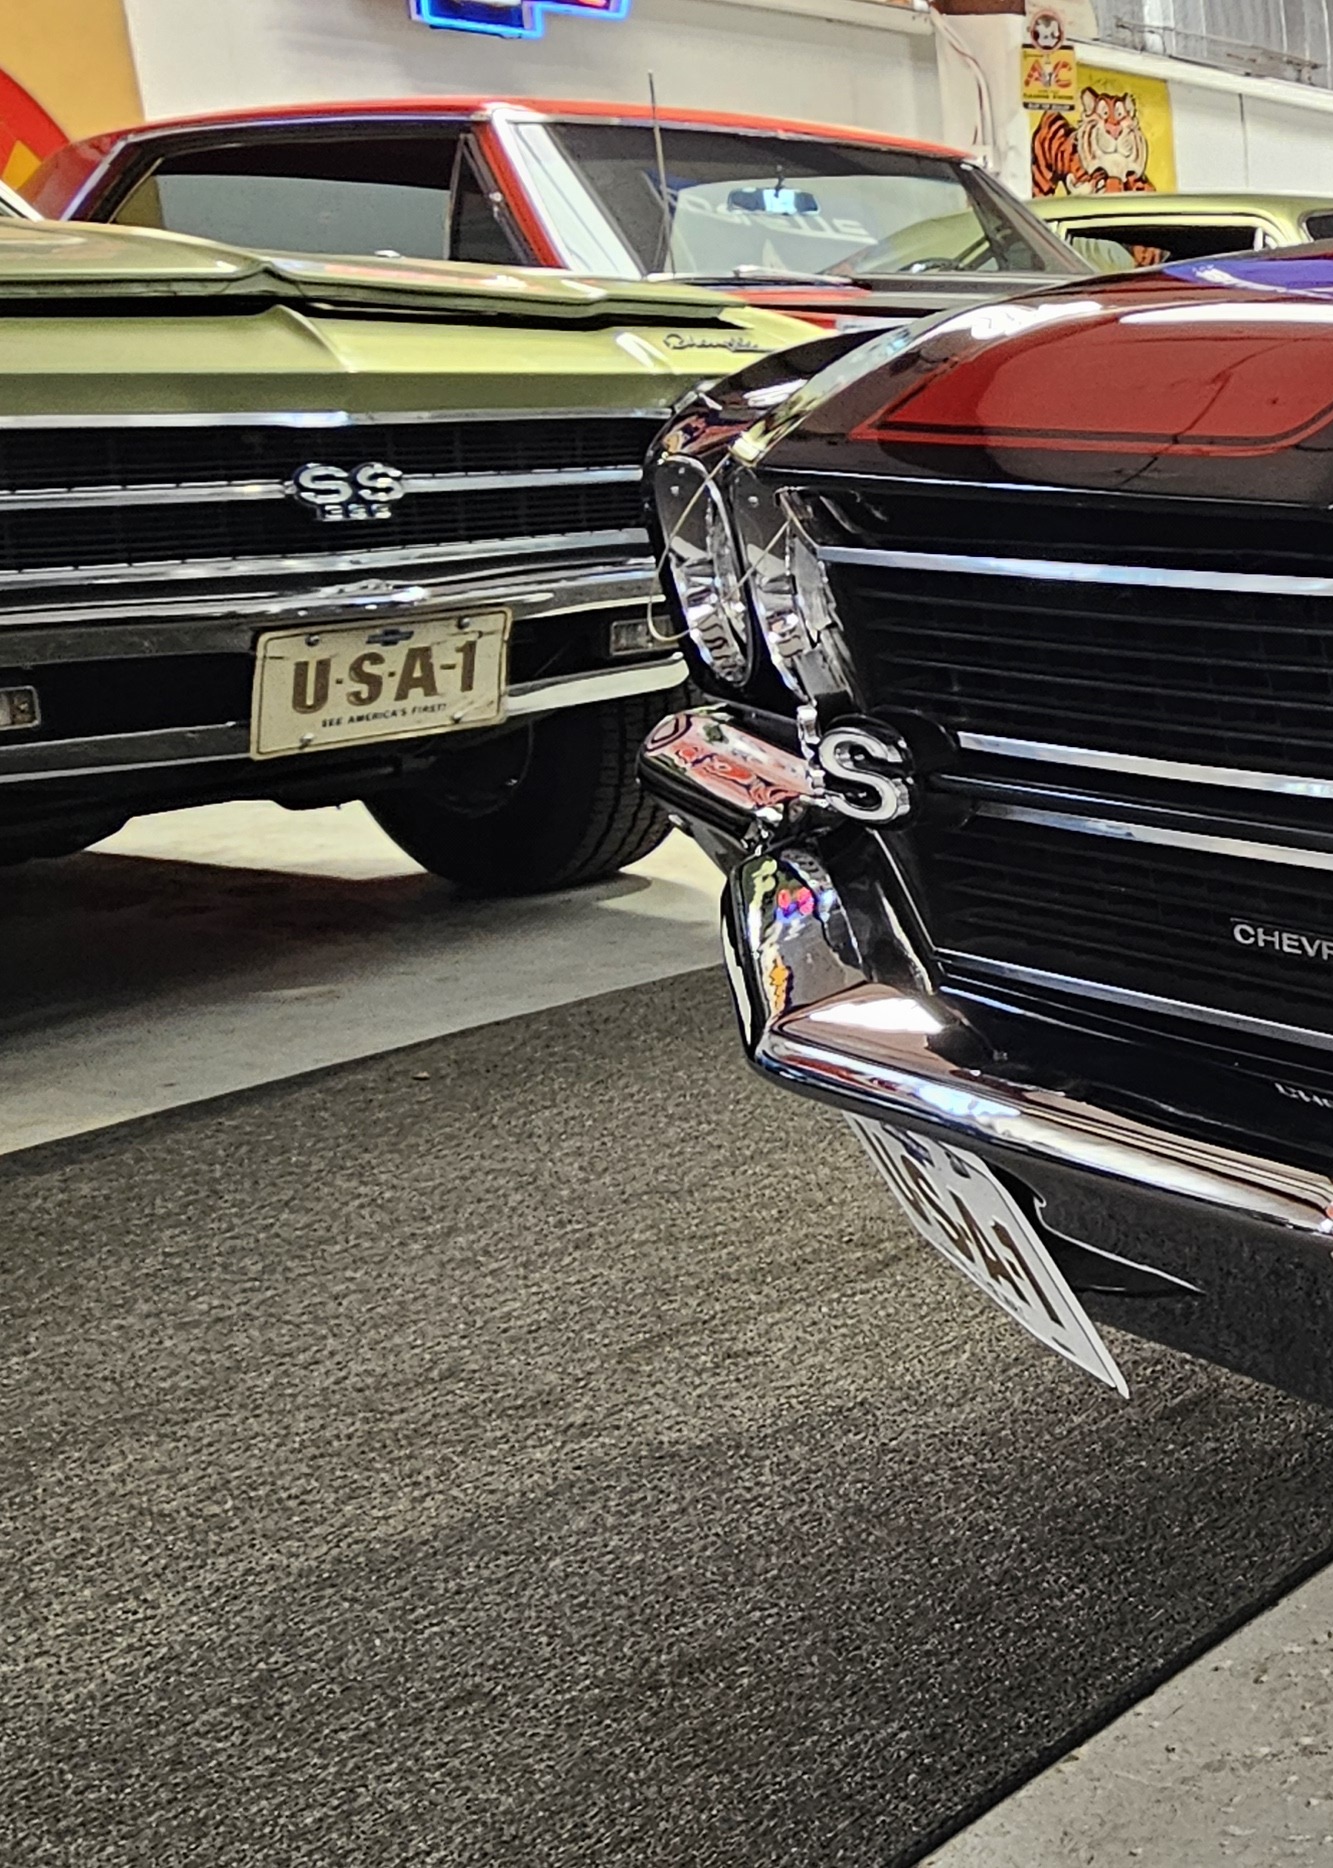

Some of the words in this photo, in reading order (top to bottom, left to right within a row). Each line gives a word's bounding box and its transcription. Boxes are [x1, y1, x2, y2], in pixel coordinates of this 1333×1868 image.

[299, 462, 404, 504] SS
[321, 717, 343, 728] SEE
[347, 708, 407, 724] AMERICA'S
